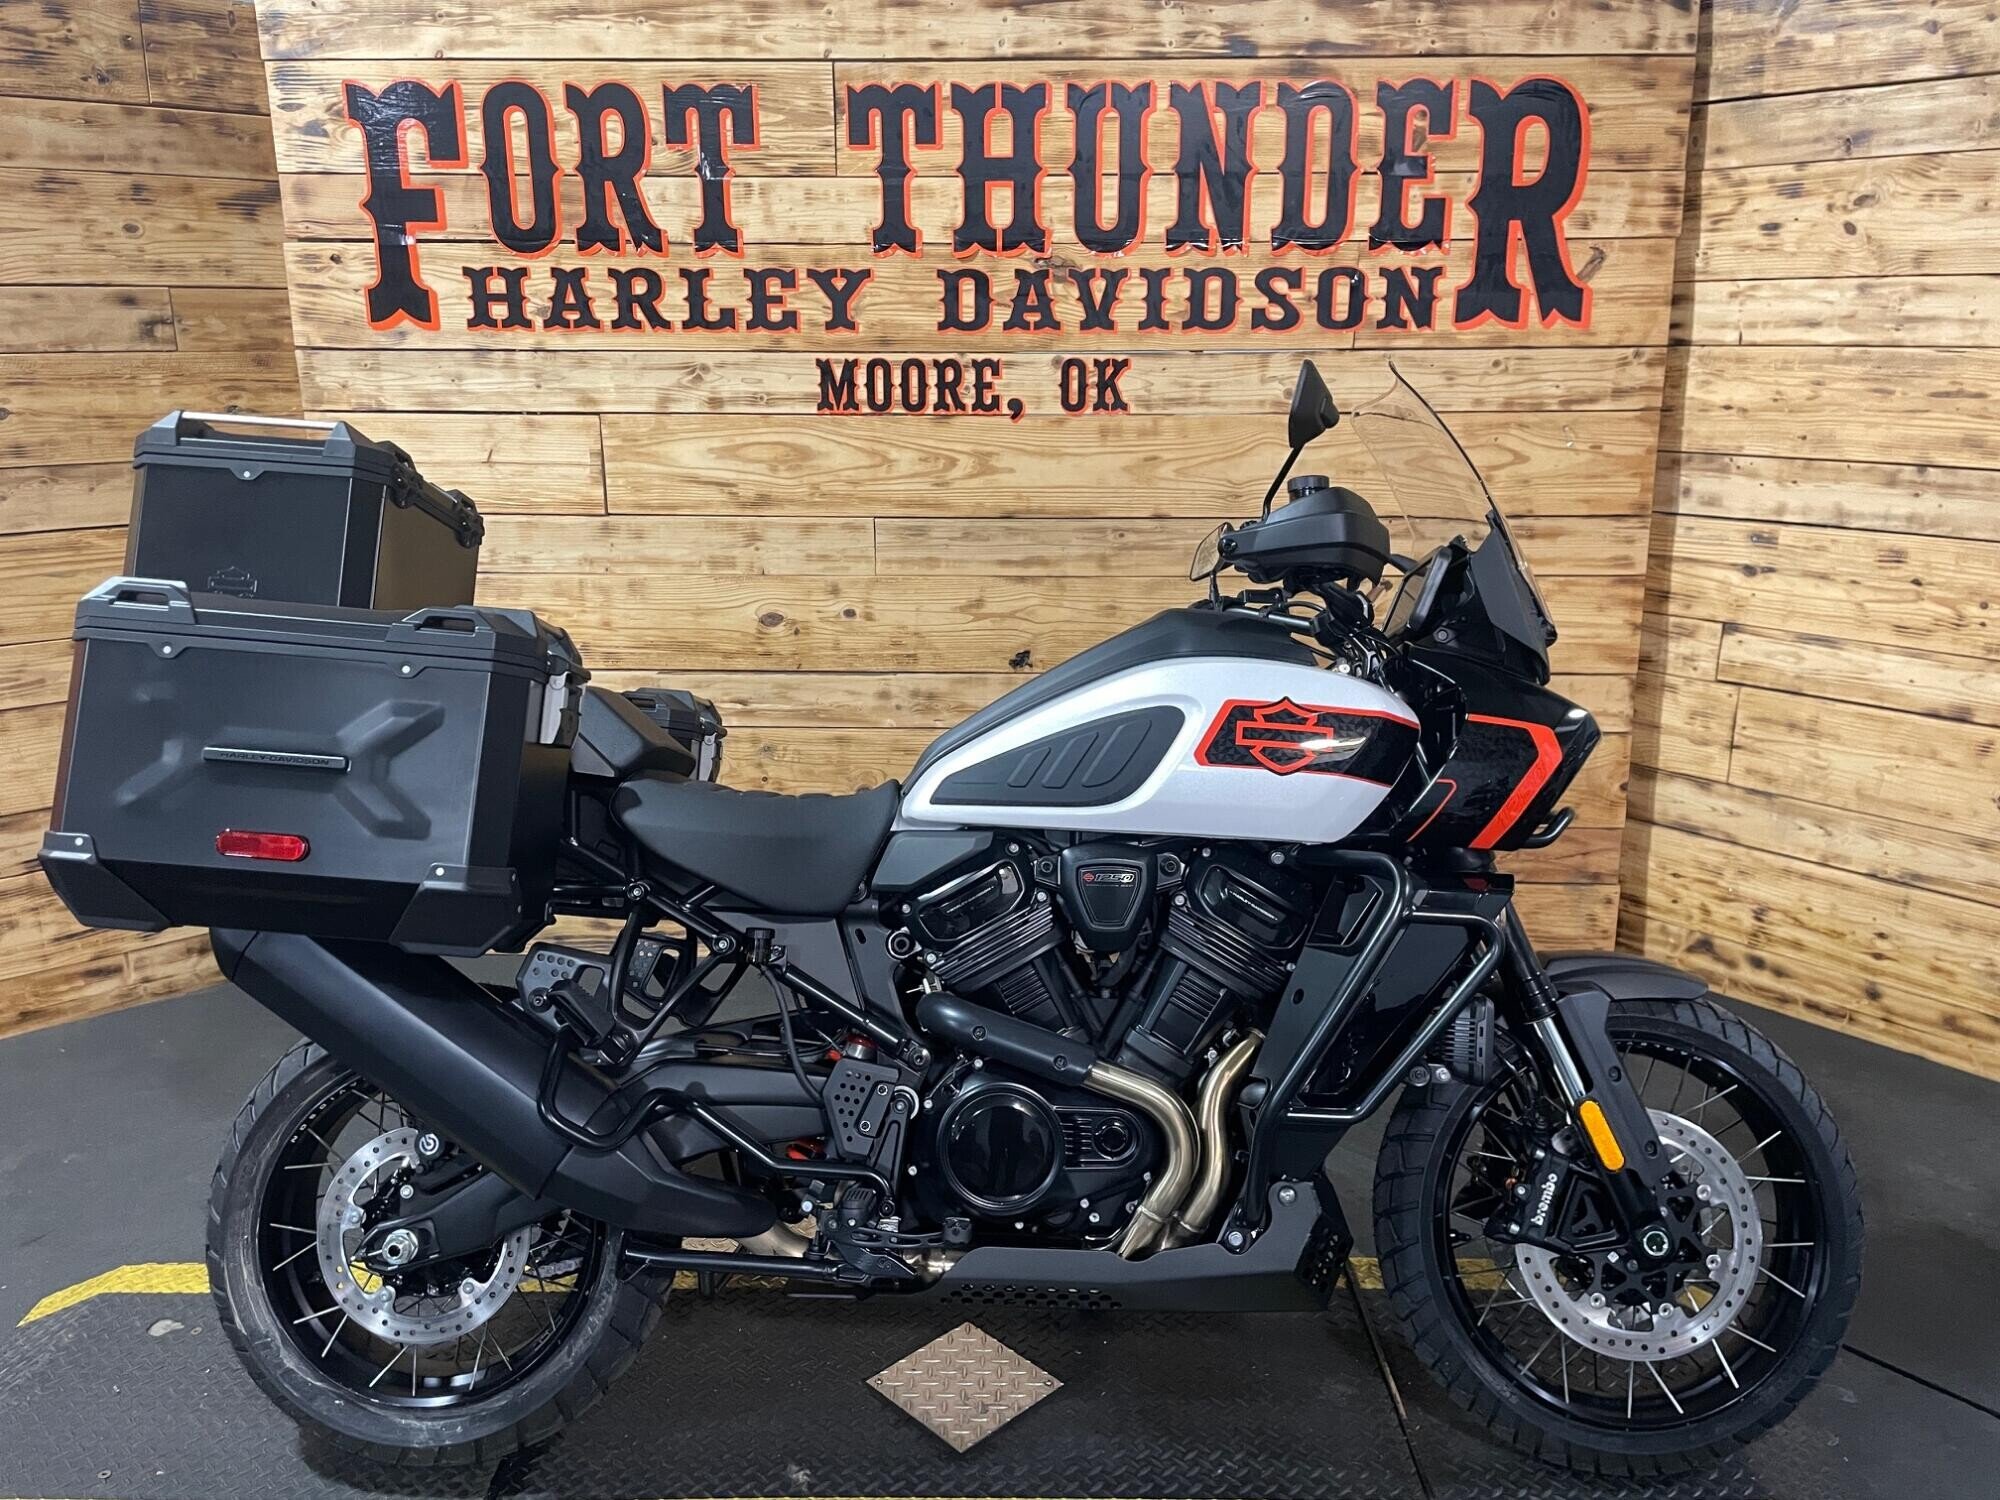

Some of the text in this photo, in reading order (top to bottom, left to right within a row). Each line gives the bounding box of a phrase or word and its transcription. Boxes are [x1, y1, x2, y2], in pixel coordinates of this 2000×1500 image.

[341, 74, 1591, 331] FORT THUNDER
[462, 265, 1446, 334] HARLEY DAVIDSON
[814, 357, 1131, 421] MOORE, OK
[1530, 1173, 1558, 1226] brembo
